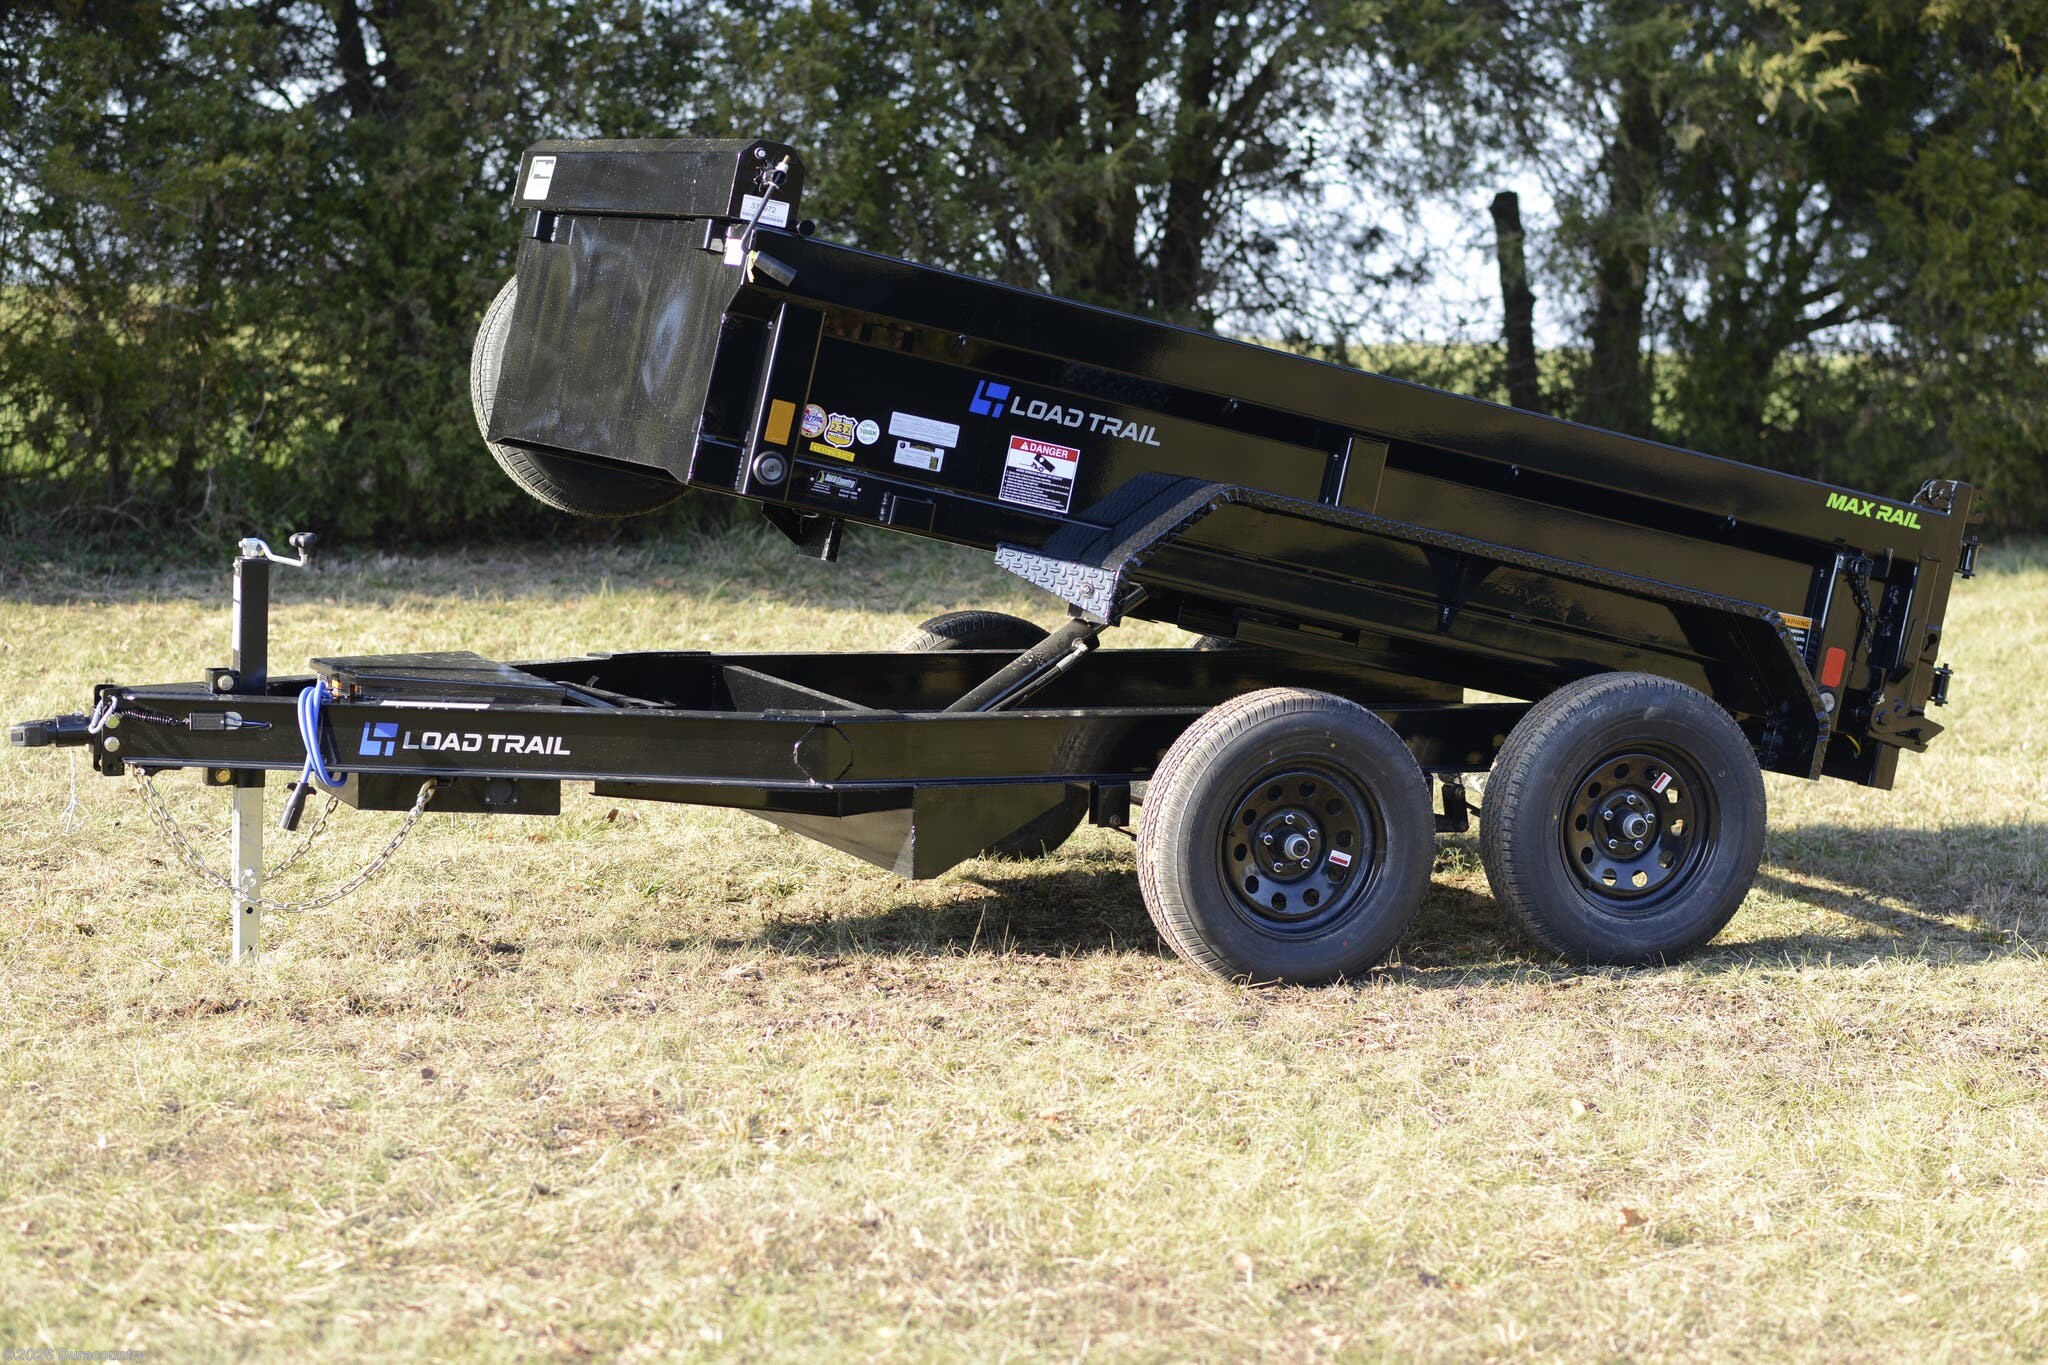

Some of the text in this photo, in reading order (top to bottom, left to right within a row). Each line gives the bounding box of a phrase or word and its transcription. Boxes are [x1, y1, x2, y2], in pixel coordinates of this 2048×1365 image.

[831, 422, 851, 434] 232
[1009, 396, 1161, 447] LOAD TRAIL
[1030, 443, 1068, 459] DANGER
[1826, 492, 1921, 530] MAX RAIL
[402, 731, 571, 756] LOAD TRAIL
